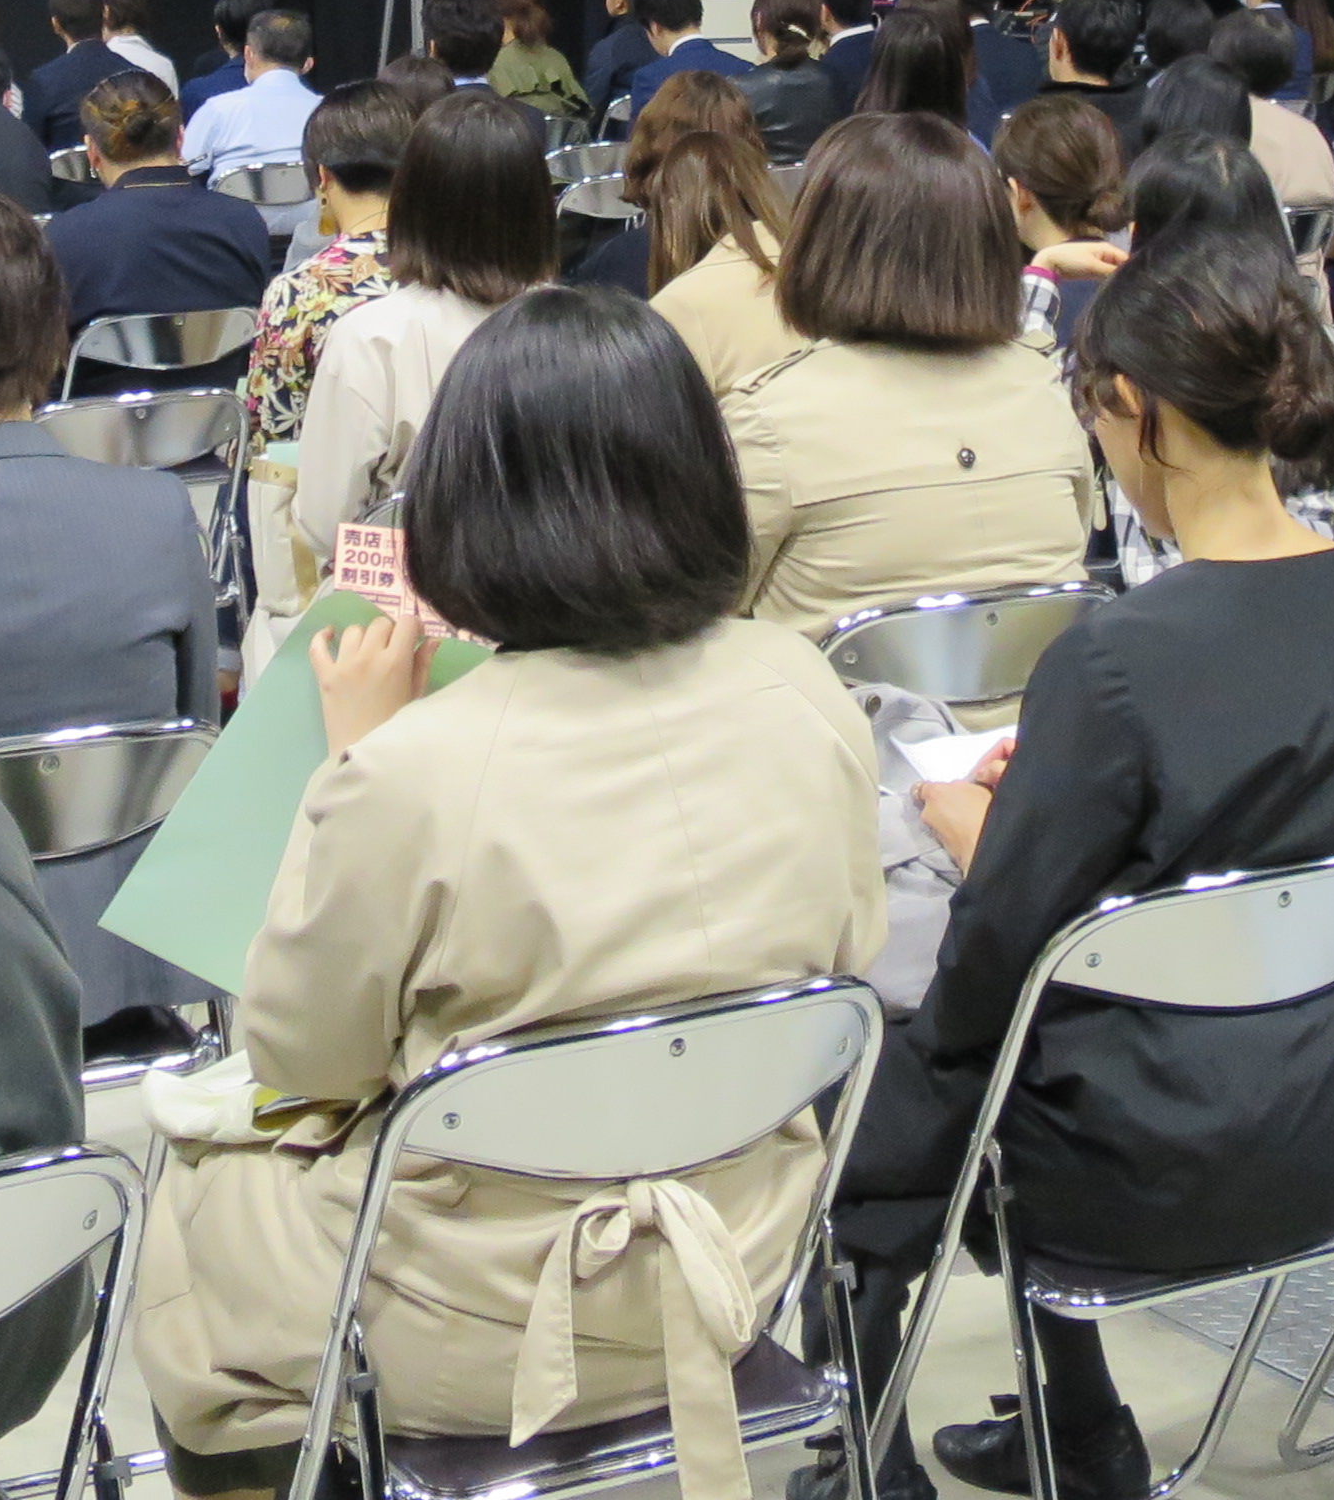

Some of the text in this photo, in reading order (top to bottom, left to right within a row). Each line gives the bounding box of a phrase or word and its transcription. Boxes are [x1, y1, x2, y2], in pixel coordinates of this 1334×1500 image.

[344, 549, 395, 569] 200円
[341, 567, 395, 588] 割引券
